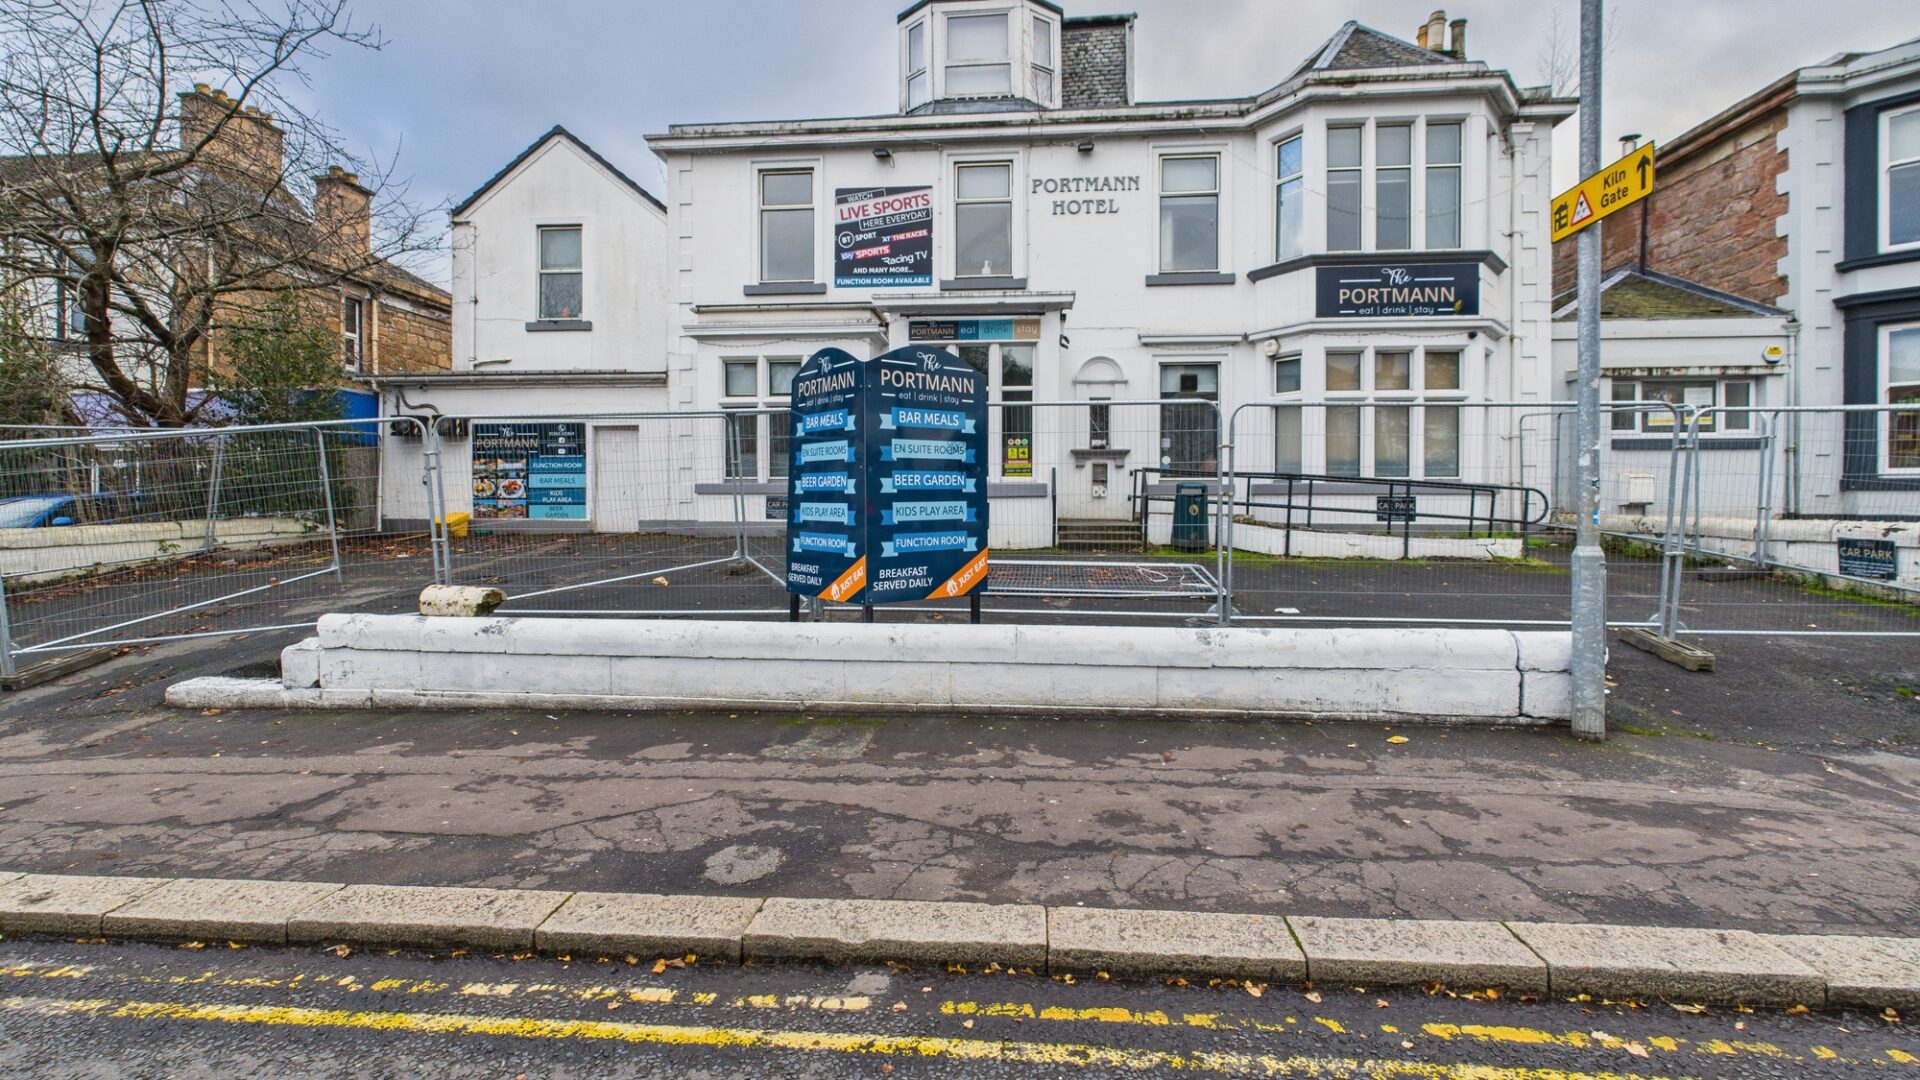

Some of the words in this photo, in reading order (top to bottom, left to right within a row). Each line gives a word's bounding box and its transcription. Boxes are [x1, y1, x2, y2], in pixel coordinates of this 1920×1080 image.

[1032, 176, 1140, 193] PORTMANN
[1603, 170, 1626, 190] Kiln
[847, 193, 873, 203] WATCH
[1601, 187, 1628, 208] Gate
[840, 204, 870, 221] LIVE
[873, 194, 930, 215] SPORTS
[1052, 199, 1120, 215] HOTEL
[863, 218, 884, 228] HERE
[886, 210, 927, 222] EVERYDAY
[855, 232, 877, 242] SPORT
[906, 230, 928, 239] RACES
[856, 244, 890, 259] SPORTS
[882, 254, 914, 265] Racing
[914, 250, 928, 260] TV
[1382, 268, 1412, 286] The
[1340, 287, 1455, 304] PORTMANN
[1382, 306, 1406, 314] drink
[1414, 306, 1434, 314] stay
[1016, 326, 1038, 334] stay
[818, 356, 832, 374] The
[917, 352, 941, 371] The
[798, 370, 855, 398] PORTMANN
[881, 369, 974, 394] PORTMANN
[817, 397, 829, 405] drink
[833, 394, 844, 402] stay
[918, 393, 938, 402] drink
[944, 396, 959, 405] stay
[806, 417, 818, 428] BAR
[820, 412, 843, 427] MEALS
[900, 411, 921, 423] BAR
[924, 413, 959, 426] MEALS
[477, 439, 538, 448] PORTMANN
[894, 444, 906, 453] EN
[908, 444, 932, 454] SUITE
[934, 446, 965, 455] ROOMS
[802, 449, 809, 457] EN
[810, 447, 824, 456] SUITE
[826, 446, 846, 455] ROOMS
[802, 477, 817, 487] BEER
[818, 476, 846, 487] GARDEN
[895, 474, 920, 486] BEER
[923, 474, 965, 486] GARDEN
[802, 507, 814, 516] KIDS
[815, 507, 828, 516] PLAY
[829, 508, 846, 517] AREA
[896, 507, 917, 516] KIDS
[920, 506, 940, 516] PLAY
[942, 506, 964, 515] AREA
[801, 537, 827, 547] FUNCTION
[828, 538, 846, 548] ROOM
[896, 538, 939, 548] FUNCTION
[941, 536, 966, 545] ROOM
[1840, 547, 1861, 556] CAR
[1864, 548, 1893, 560] PARK
[792, 562, 819, 574] BREAKFAST
[880, 566, 928, 579] BREAKFAST
[959, 570, 974, 587] JUST
[974, 558, 986, 572] EAT
[789, 573, 806, 583] SERVED
[807, 576, 822, 586] DAILY
[840, 576, 852, 594] JUST
[853, 567, 864, 581] EAT
[874, 579, 906, 591] SERVED
[909, 578, 933, 589] DAILY
